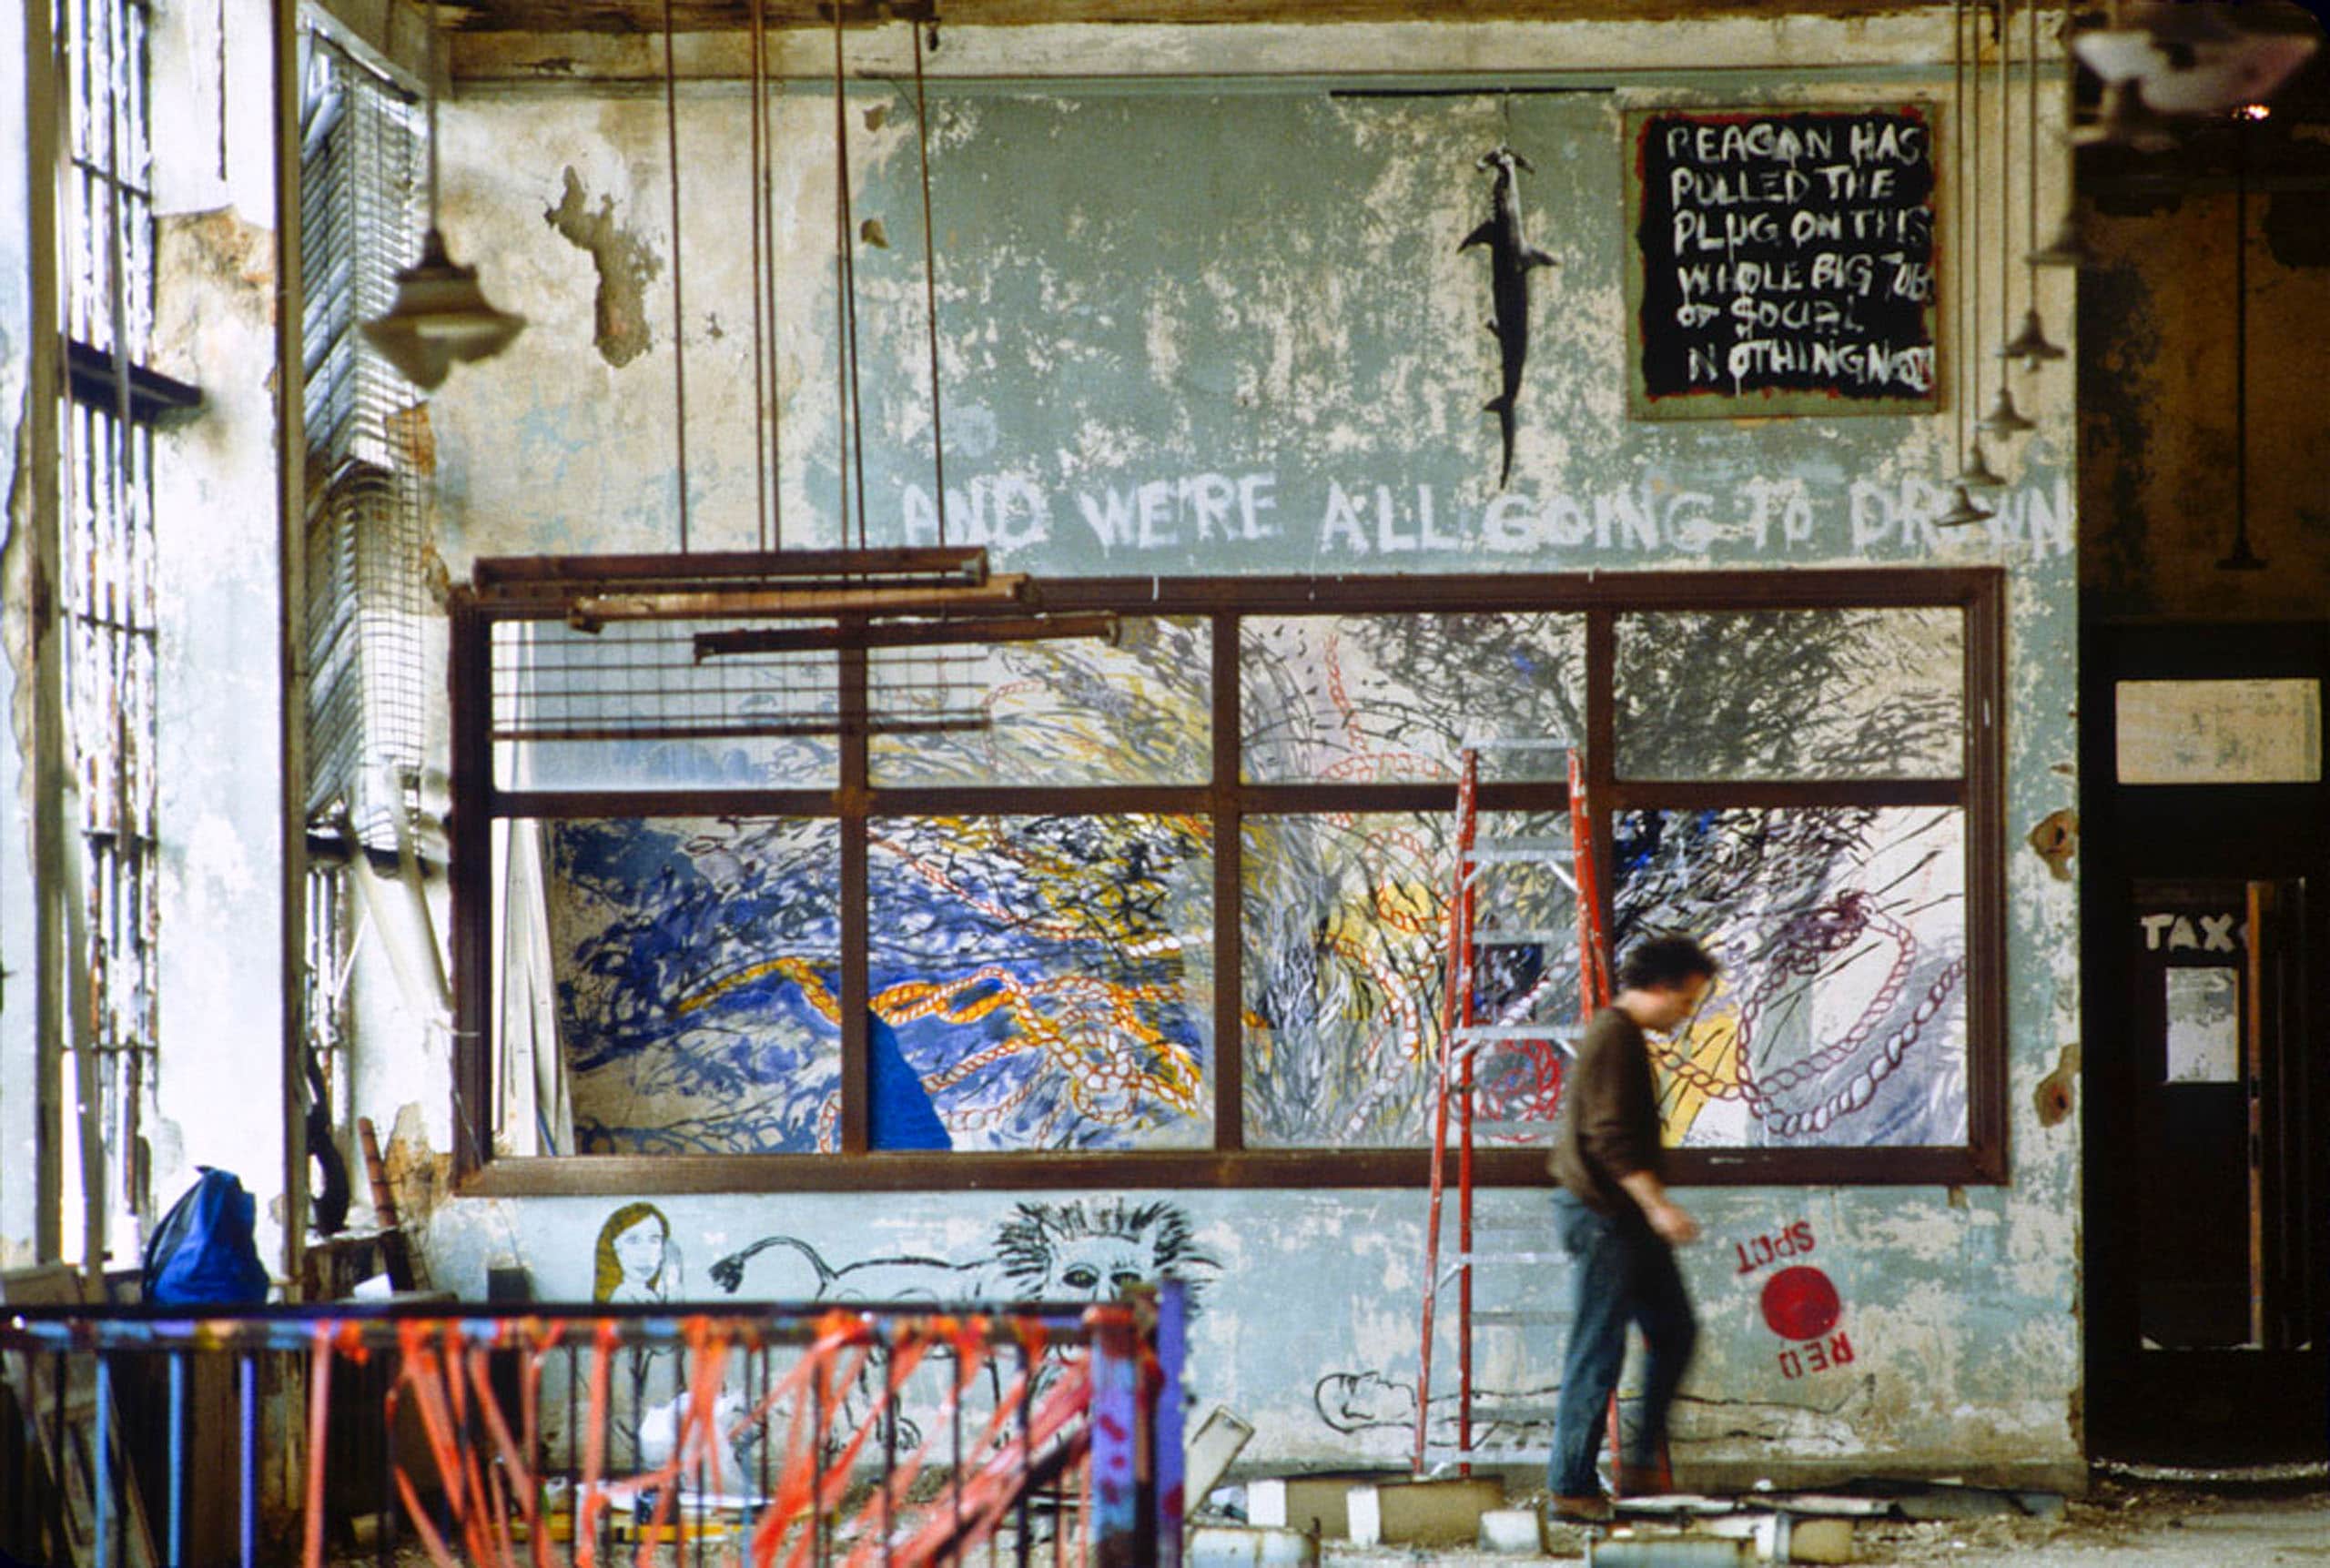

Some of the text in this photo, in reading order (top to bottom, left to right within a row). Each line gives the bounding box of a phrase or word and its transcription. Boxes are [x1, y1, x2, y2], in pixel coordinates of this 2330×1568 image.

[1849, 122, 1921, 167] HAS
[1670, 164, 1896, 210] PULLED THE
[1673, 209, 1779, 260] PLUG
[1790, 209, 1843, 246] ON
[1677, 261, 1804, 297] WHOLE
[1810, 251, 1874, 297] BIG
[903, 475, 1053, 548] AND
[1078, 472, 1280, 557] WE'RE
[1322, 481, 1459, 555] ALL
[1483, 484, 1714, 552] GOING
[1737, 476, 1814, 551] TO
